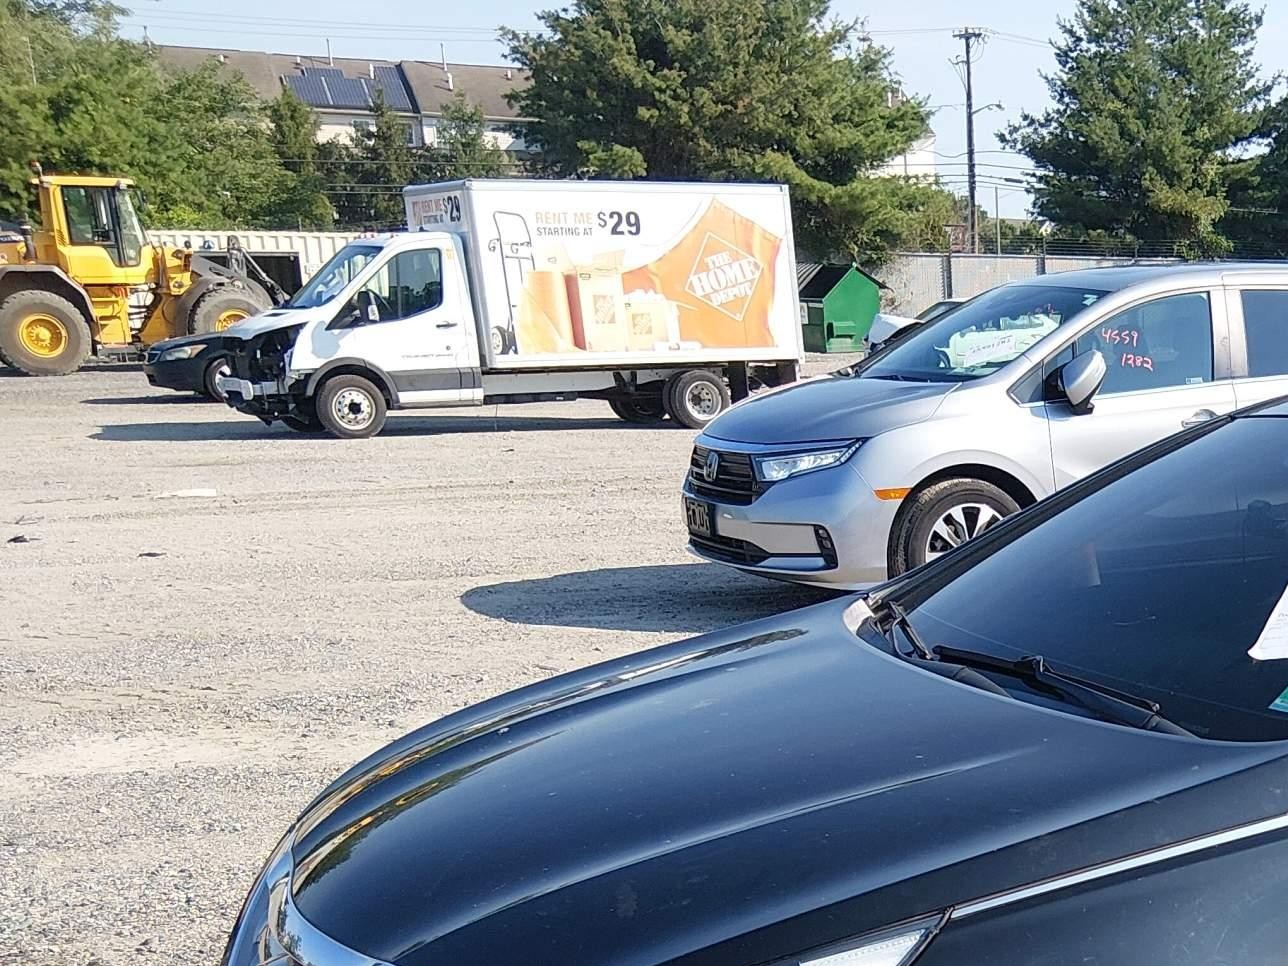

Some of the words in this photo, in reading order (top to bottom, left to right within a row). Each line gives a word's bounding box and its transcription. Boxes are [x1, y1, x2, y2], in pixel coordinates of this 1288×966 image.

[442, 195, 461, 222] $29
[536, 211, 568, 225] RENT
[573, 211, 593, 224] ME
[536, 226, 580, 237] STARTING
[583, 227, 593, 236] AT
[597, 210, 641, 236] $29
[704, 251, 732, 269] THE
[692, 257, 759, 297] HOME
[710, 280, 753, 306] DEPOT
[1102, 328, 1138, 347] 4559
